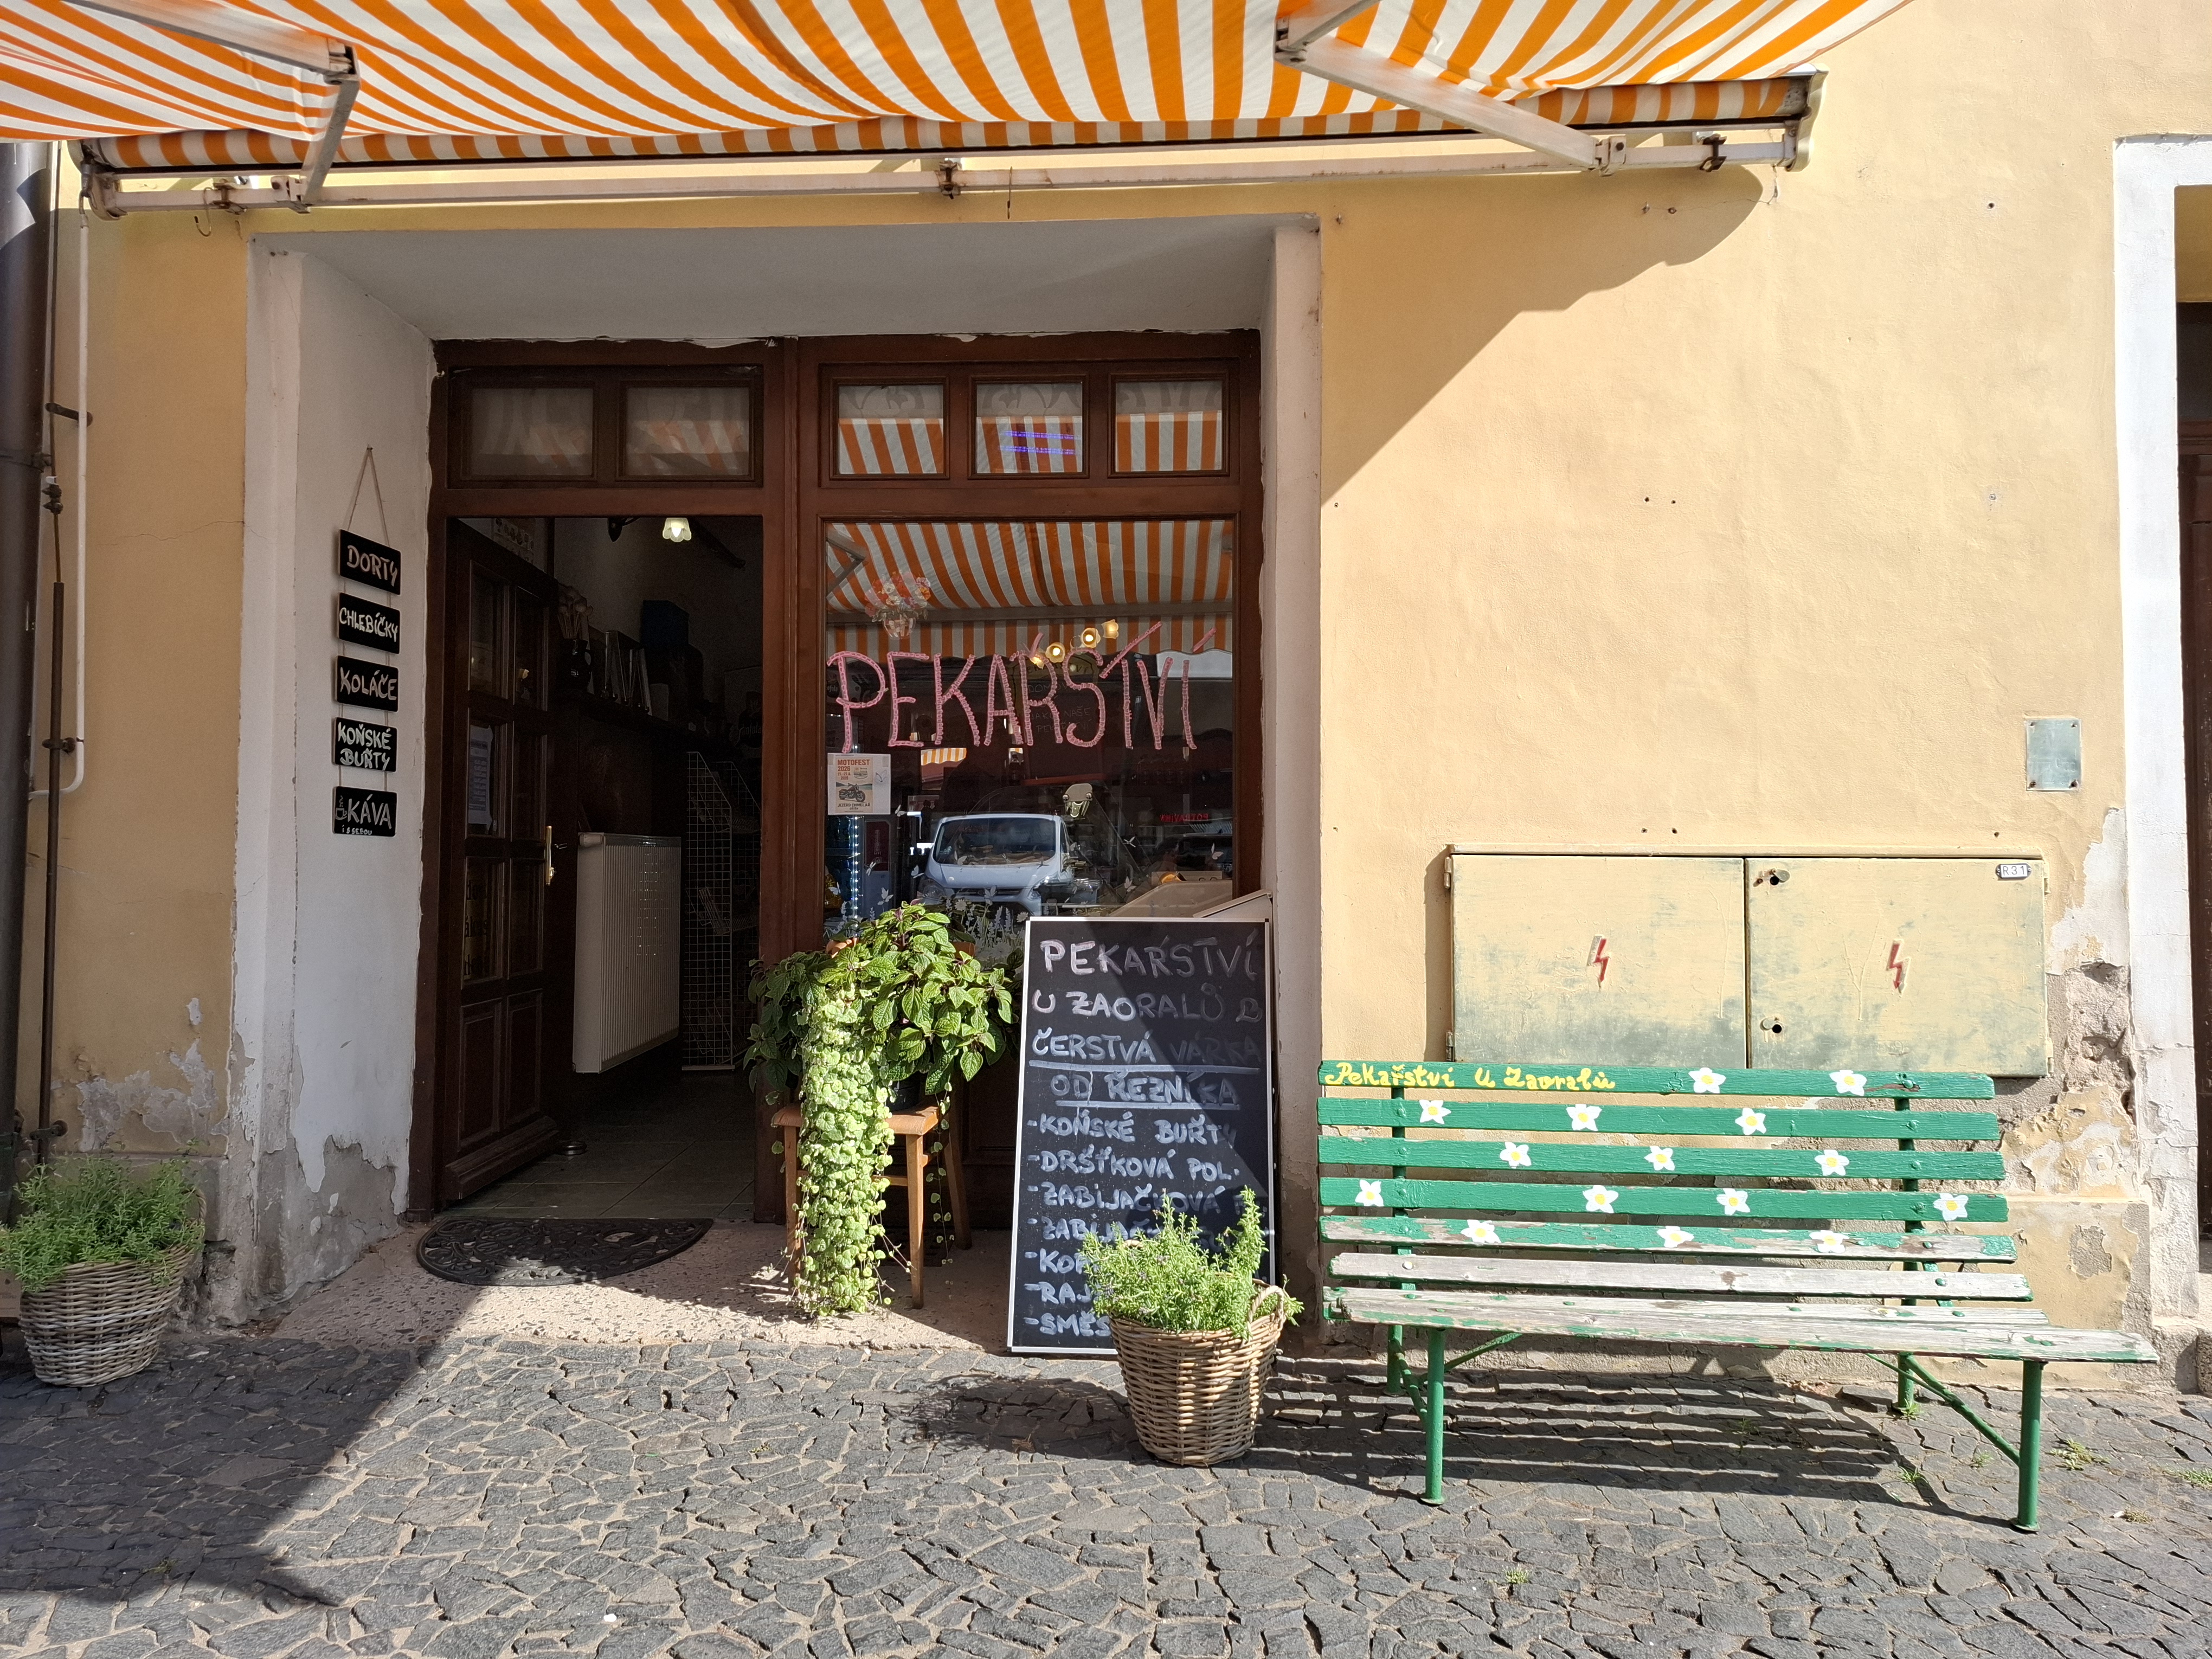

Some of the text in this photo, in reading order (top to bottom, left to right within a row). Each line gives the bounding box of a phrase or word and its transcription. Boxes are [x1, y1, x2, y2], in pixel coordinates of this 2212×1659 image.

[346, 545, 398, 587] DORTY
[339, 607, 398, 642] CHLEBÍČKY
[340, 666, 397, 700] KOLÁČE
[338, 722, 392, 750] KOŇSKÉ
[340, 748, 390, 771] BUŘTY
[348, 793, 392, 829] KÁVA
[2003, 865, 2025, 876] R31
[1032, 982, 1225, 1023] U ZAORALŮ
[1032, 1027, 1156, 1064] ČERSTVÁ
[1051, 1068, 1239, 1105] OD ŘEZNÍKA
[1475, 1067, 1496, 1088] U
[1154, 1114, 1237, 1148] BUŘTY
